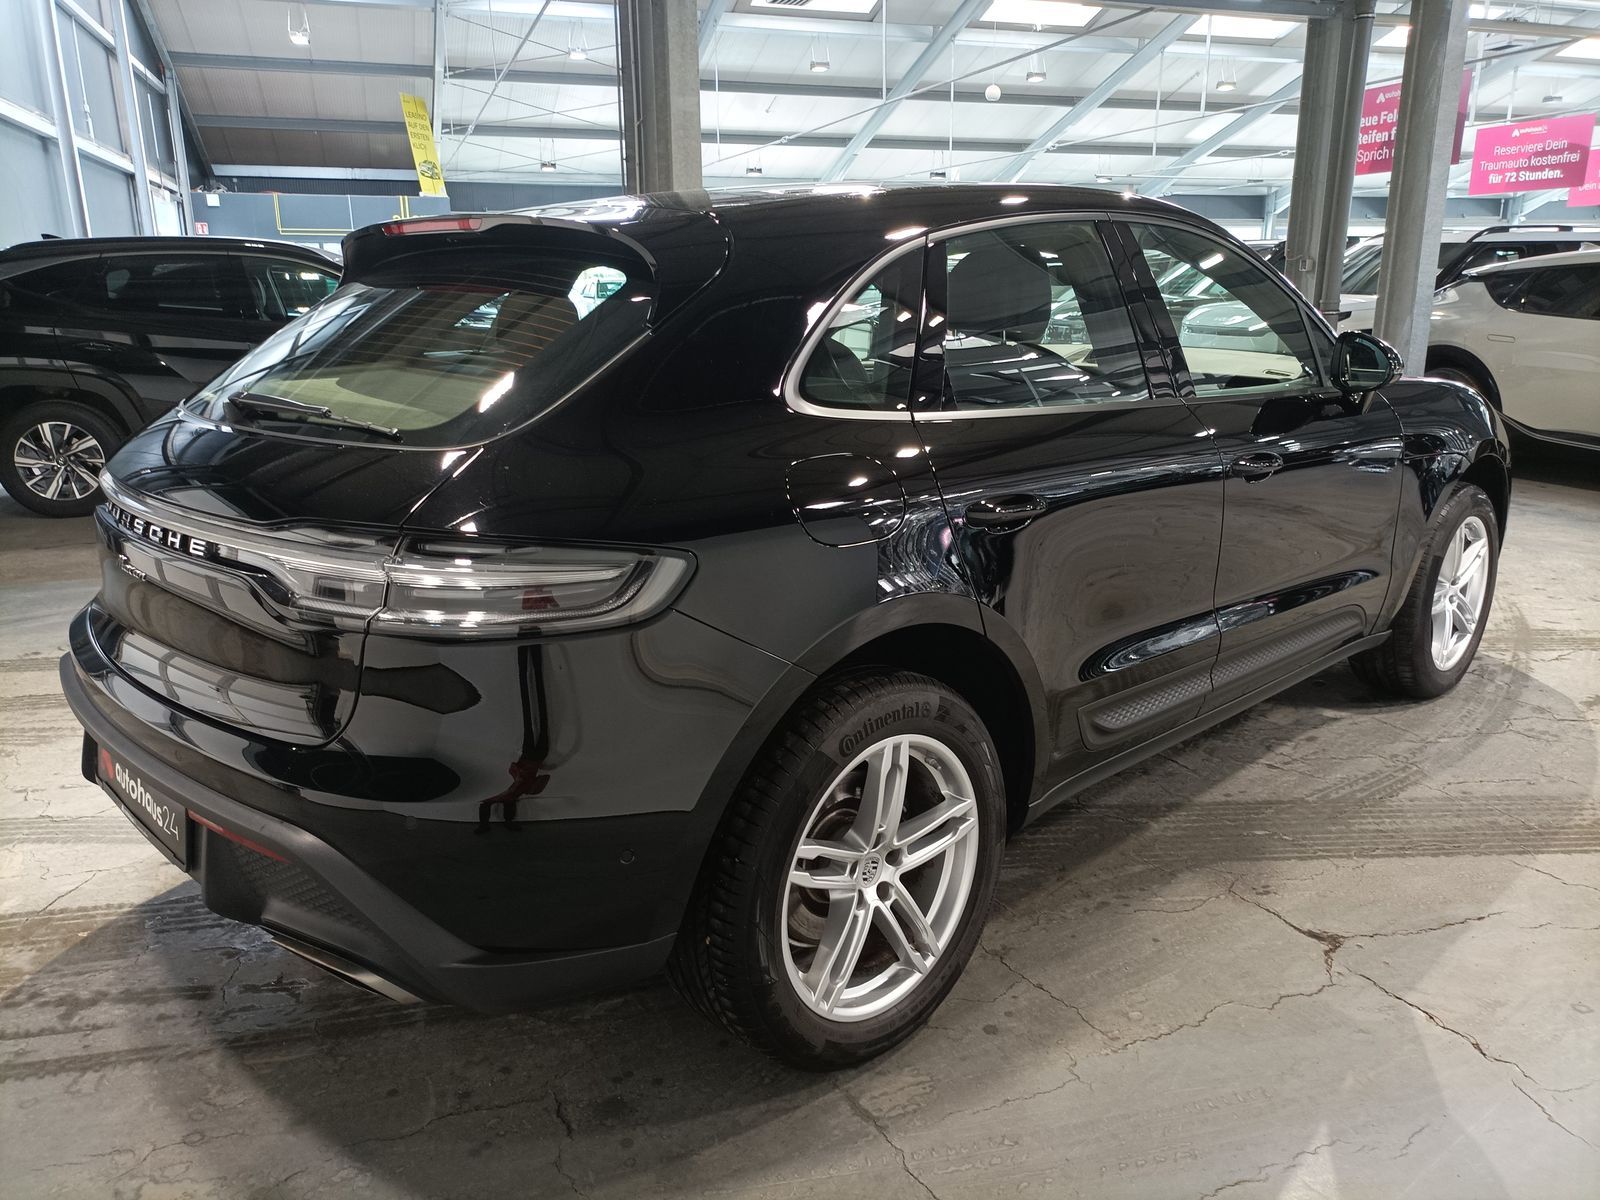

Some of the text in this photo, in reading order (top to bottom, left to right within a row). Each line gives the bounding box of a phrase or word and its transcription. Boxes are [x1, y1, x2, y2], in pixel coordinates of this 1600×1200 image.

[410, 132, 430, 141] ERSTEN
[1357, 146, 1389, 164] Sprich
[1493, 138, 1568, 156] Reserviere Dein
[1480, 150, 1581, 171] Traumauto kostenfrei
[1488, 168, 1564, 184] für 72 Stunden.
[105, 501, 206, 557] PORSCHE
[838, 702, 920, 757] Continental
[115, 762, 179, 841] autohaus24
